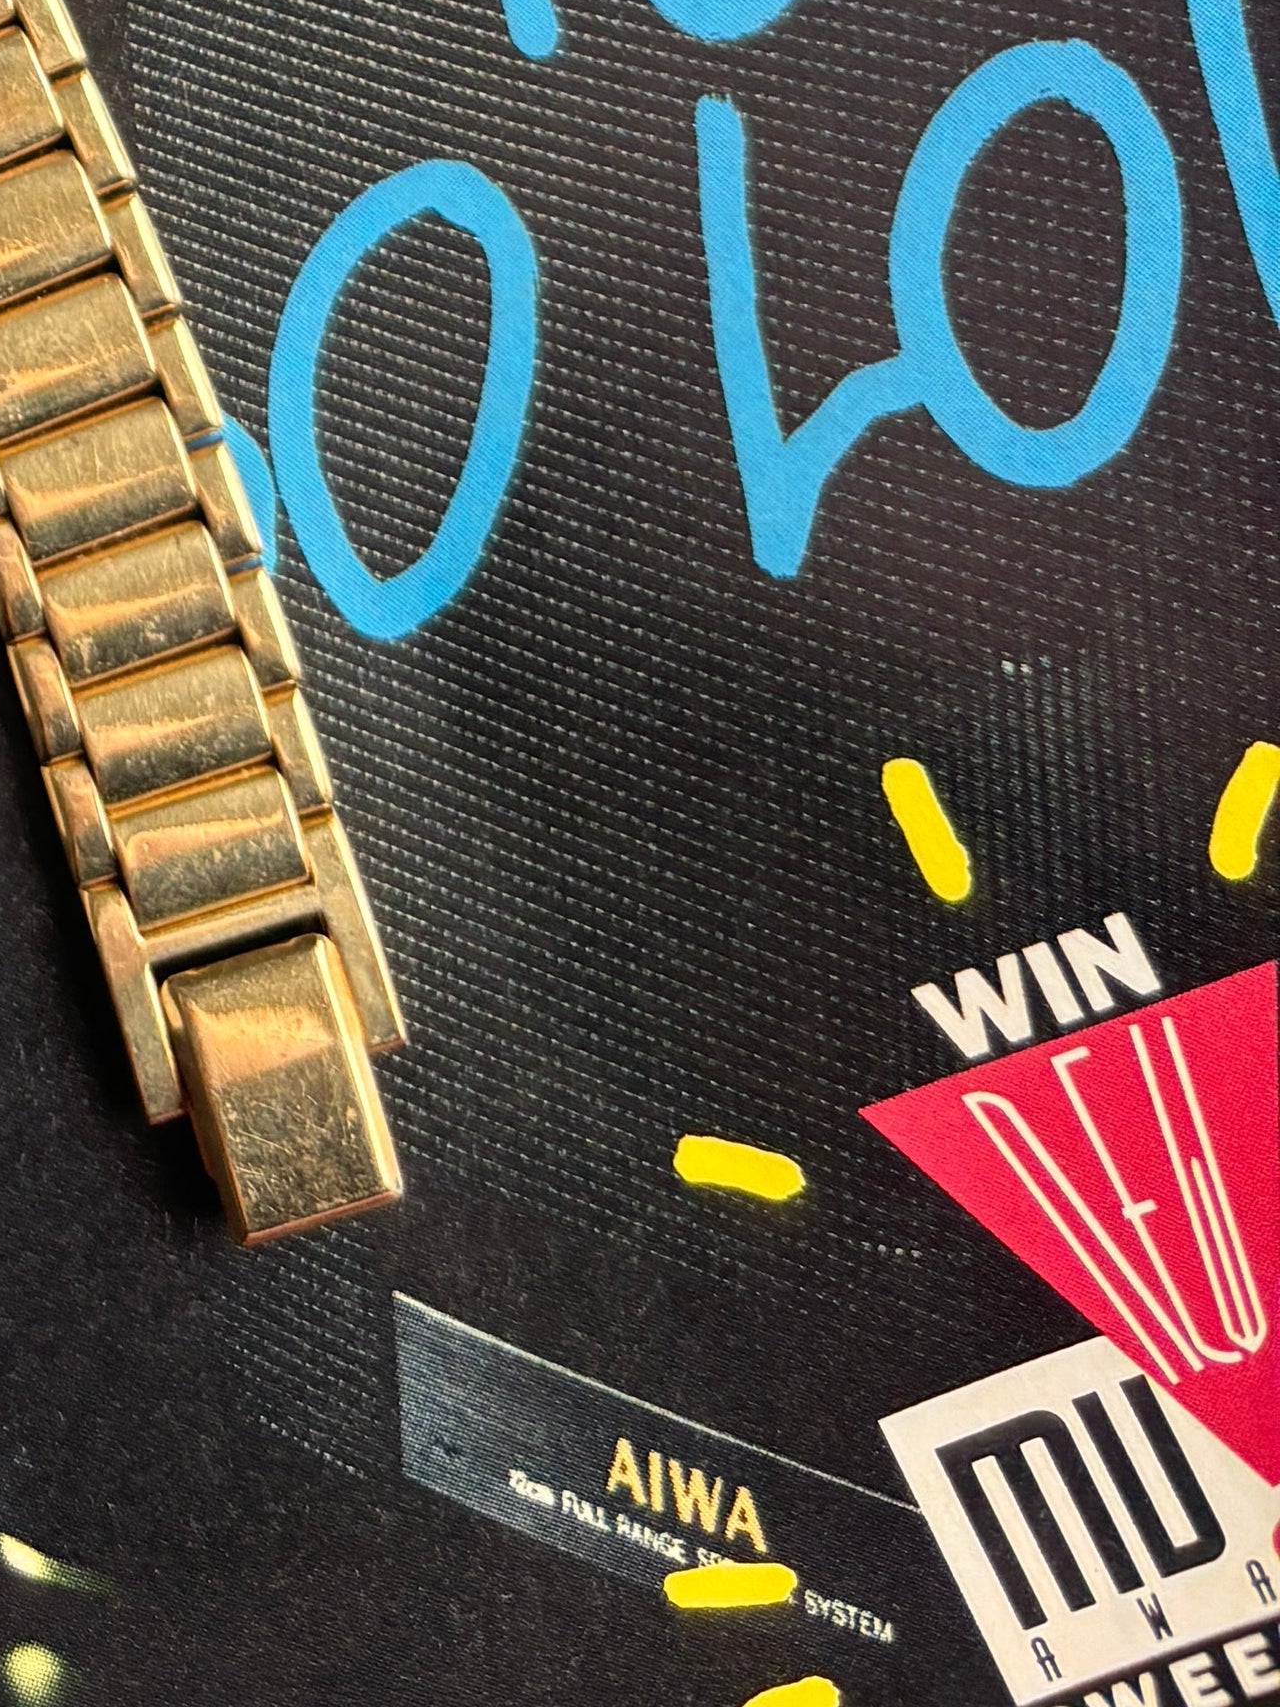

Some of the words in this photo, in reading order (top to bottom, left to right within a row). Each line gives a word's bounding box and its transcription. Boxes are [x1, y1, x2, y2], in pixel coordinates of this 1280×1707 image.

[910, 911, 1162, 1058] WIN
[561, 1489, 612, 1533] FULL
[804, 1588, 896, 1645] SYSTEM
[606, 1437, 770, 1555] AIWA
